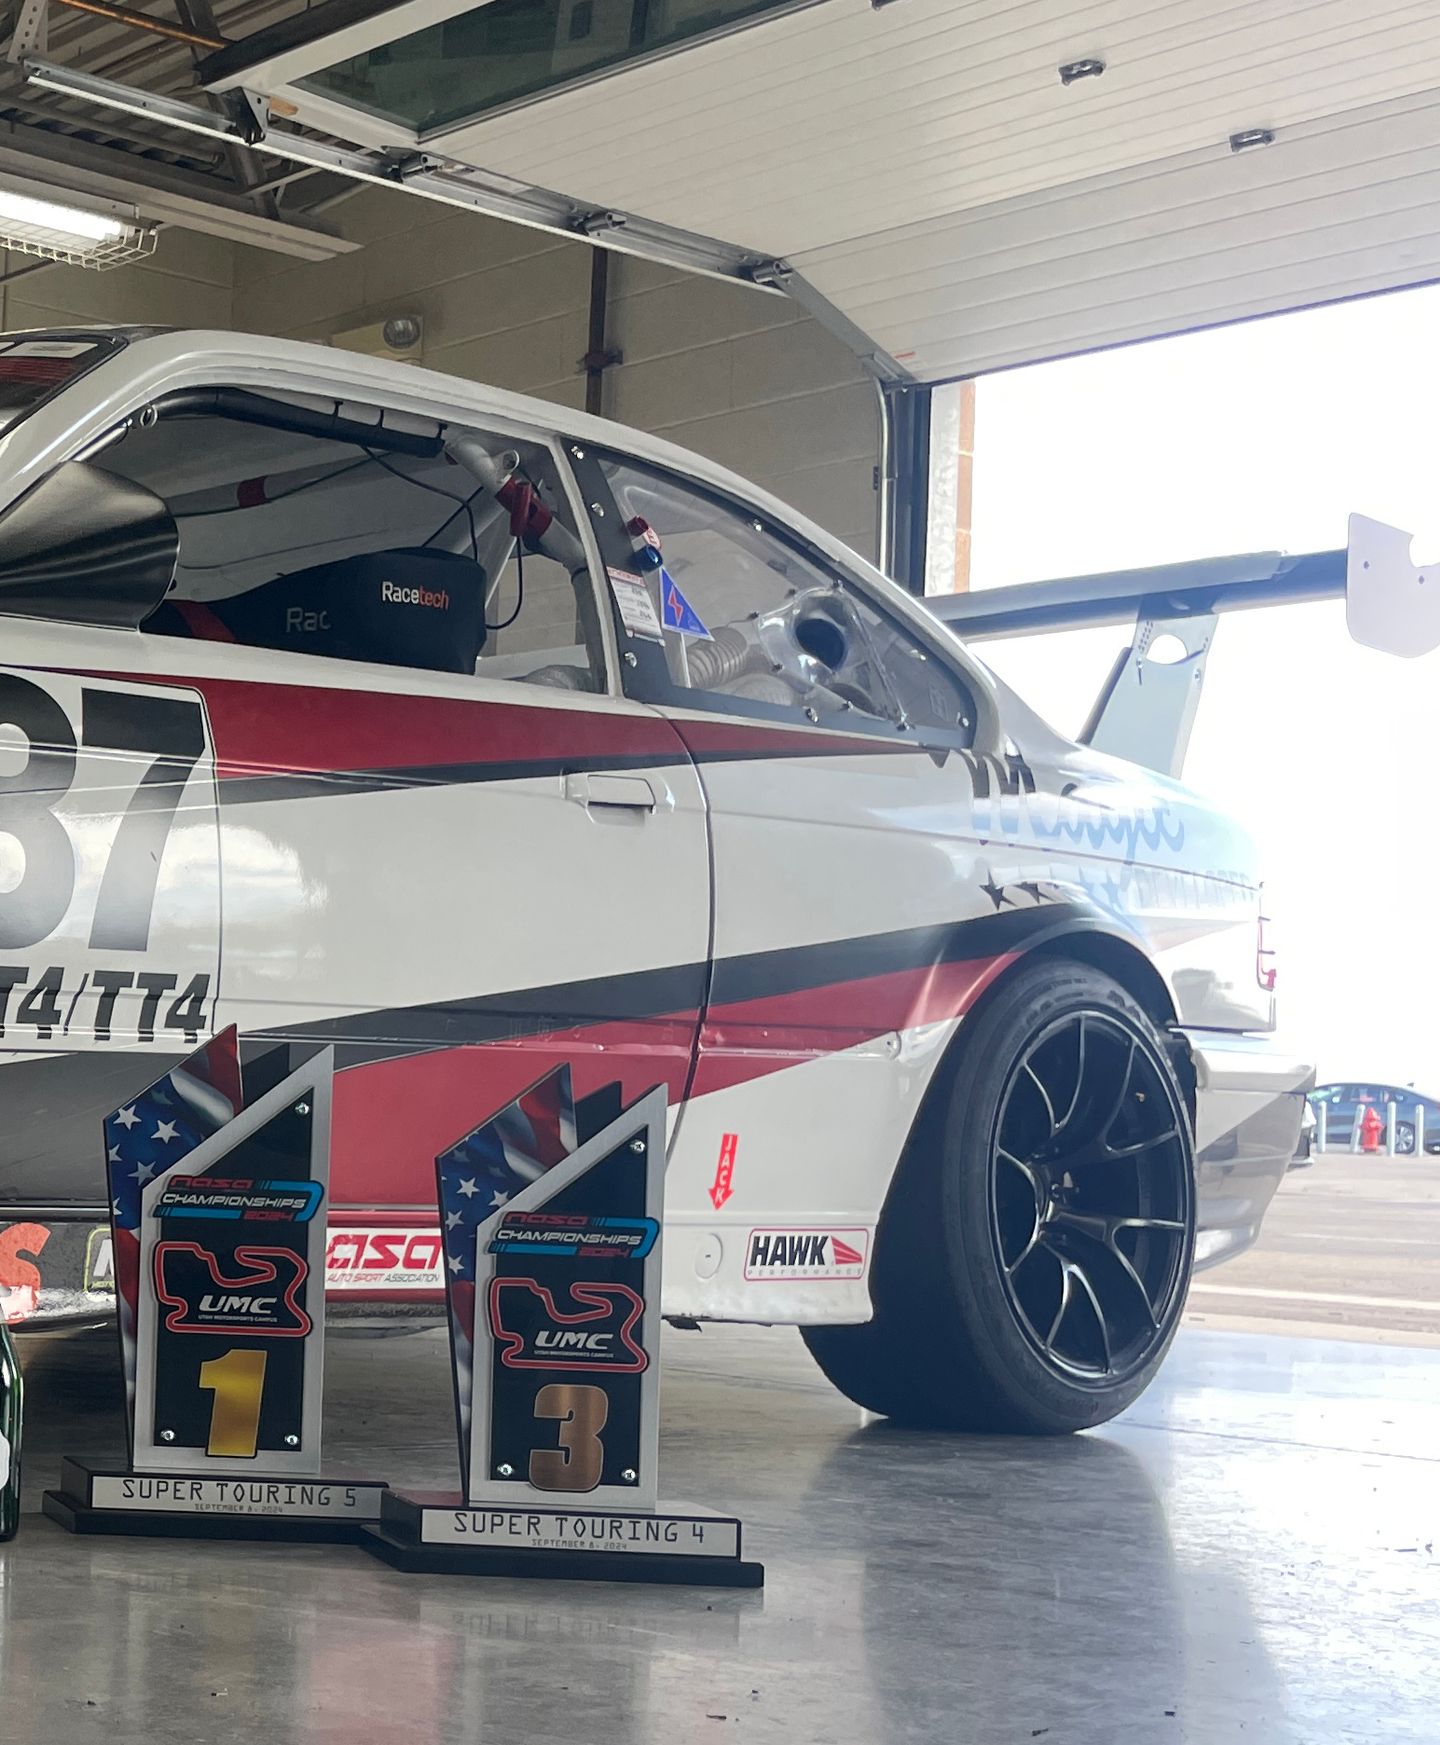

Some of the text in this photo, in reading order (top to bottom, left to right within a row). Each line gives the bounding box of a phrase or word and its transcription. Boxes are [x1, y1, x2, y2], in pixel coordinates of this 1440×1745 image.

[381, 581, 449, 610] Racetech
[716, 1135, 733, 1202] JACK
[162, 1193, 306, 1209] CHAMPIONSHIPS
[243, 1210, 295, 1222] 2024
[497, 1229, 642, 1246] CHAMPIONSHIPS
[749, 1235, 829, 1267] HAWK
[199, 1295, 277, 1314] UMC
[535, 1331, 614, 1350] UMC
[198, 1347, 268, 1458] 1
[528, 1383, 610, 1493] 3
[122, 1479, 356, 1507] SUPER TOURING 5
[454, 1513, 705, 1543] SUPER TOURING 4
